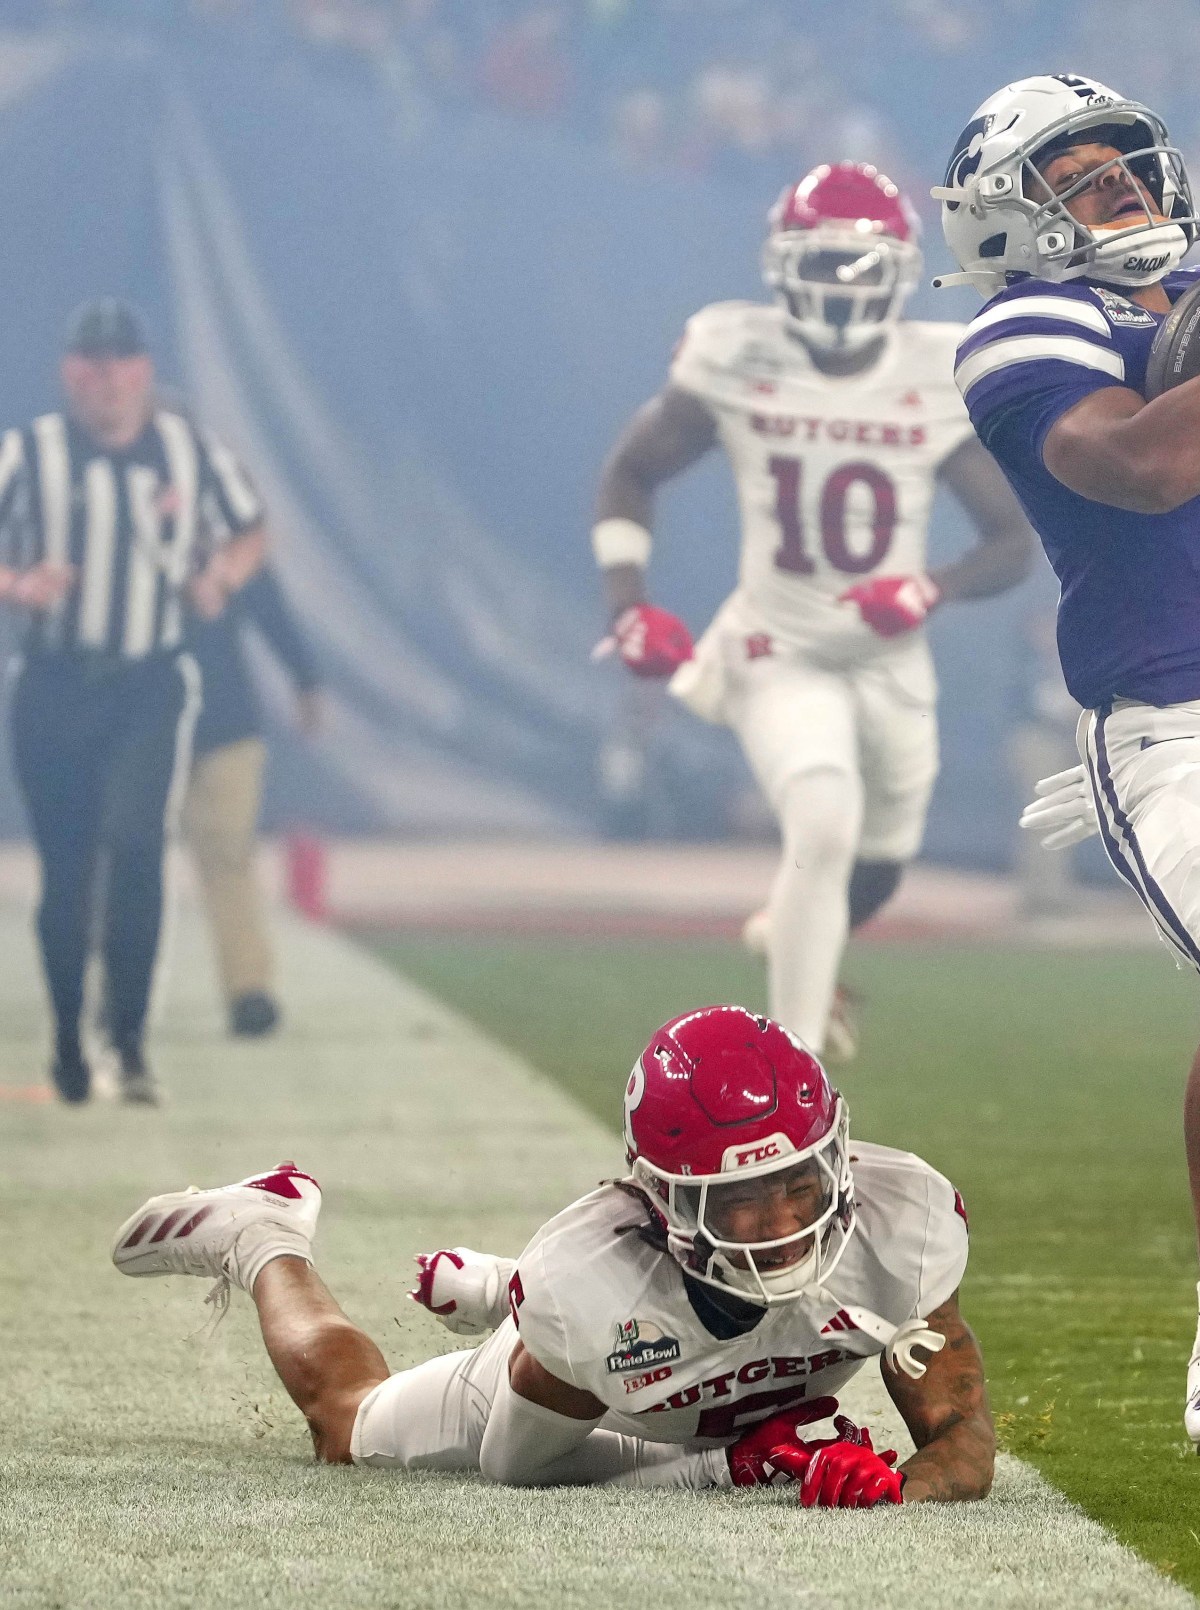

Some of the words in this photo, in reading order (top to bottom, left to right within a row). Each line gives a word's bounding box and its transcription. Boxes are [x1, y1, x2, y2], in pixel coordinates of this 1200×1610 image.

[1173, 333, 1191, 373] ELITE
[750, 412, 927, 445] RUTGERS
[768, 453, 896, 575] 10
[736, 1142, 781, 1167] FTC
